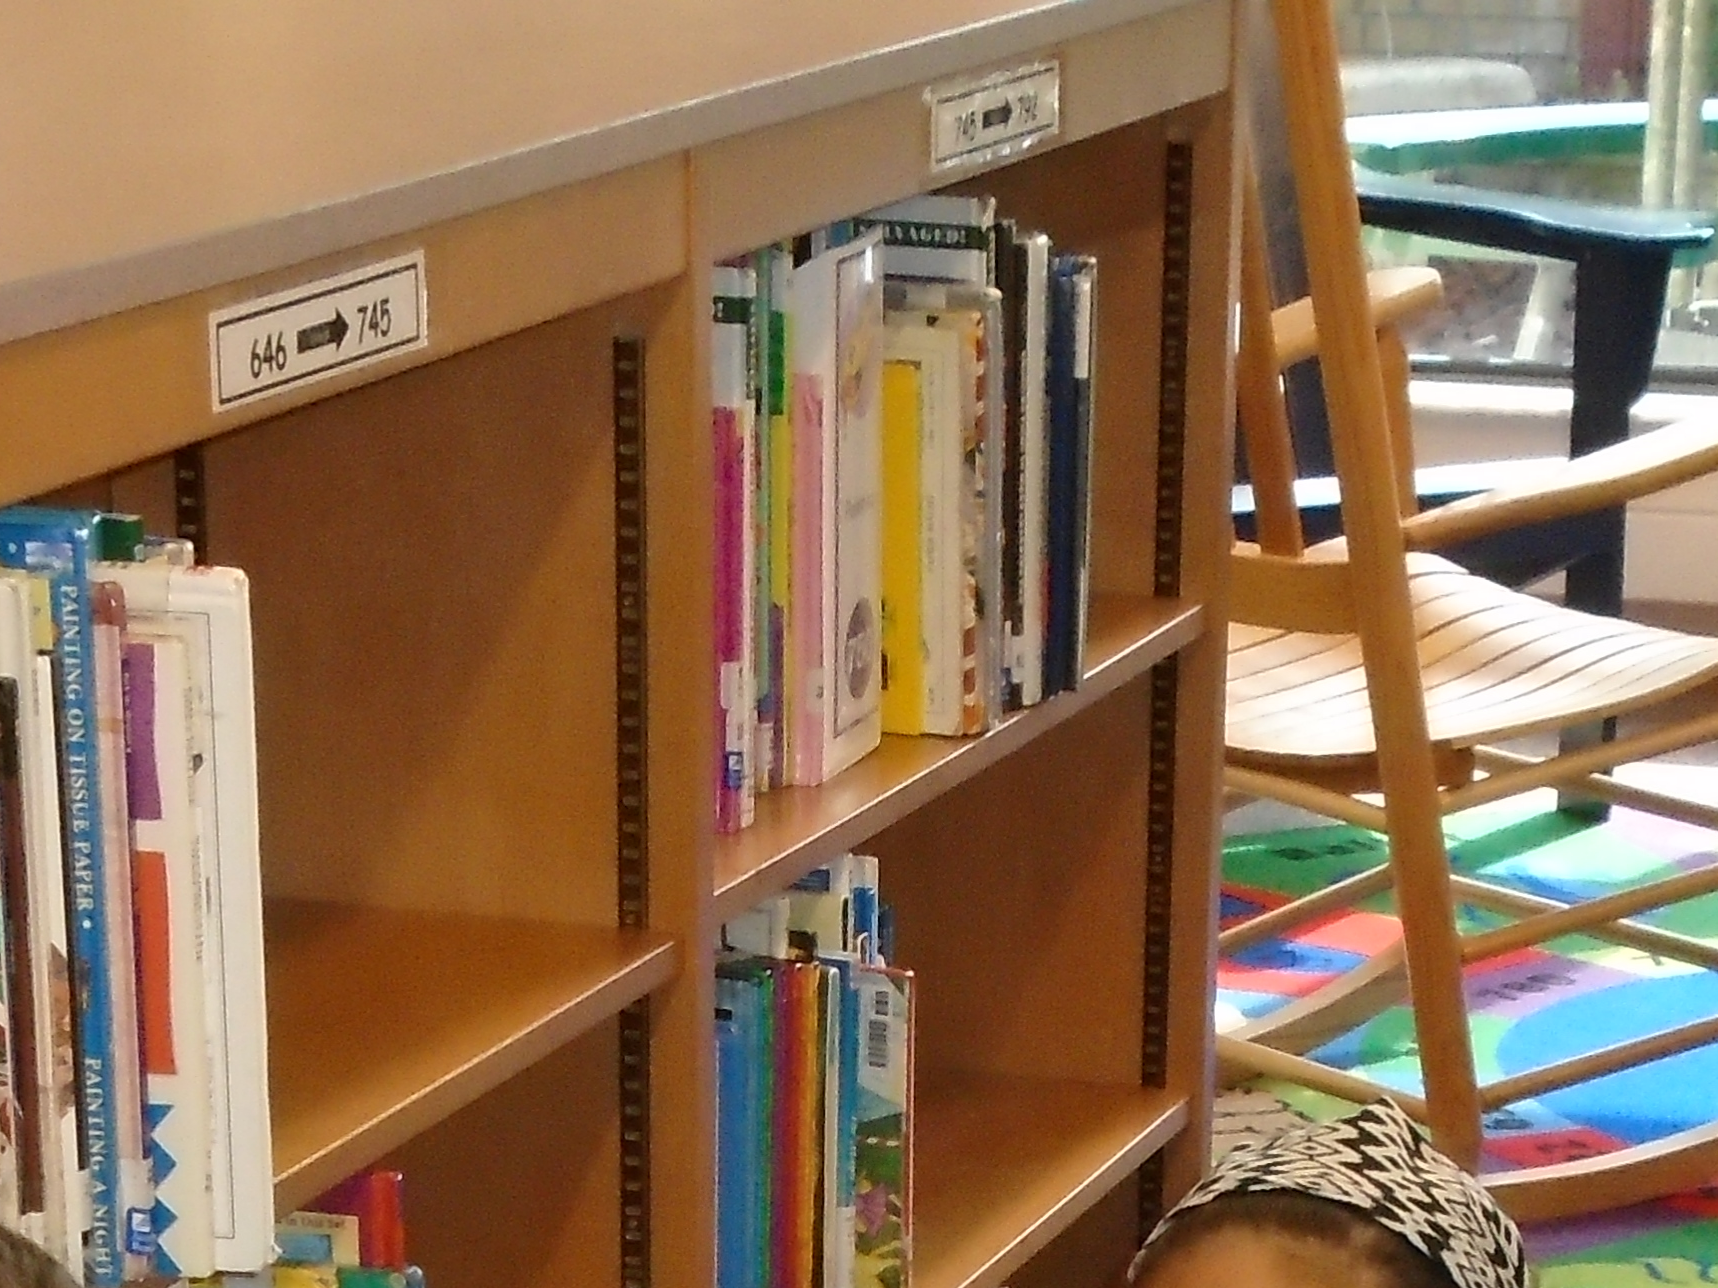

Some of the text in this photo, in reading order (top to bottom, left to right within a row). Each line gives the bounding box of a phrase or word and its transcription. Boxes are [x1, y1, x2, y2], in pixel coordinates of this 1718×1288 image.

[250, 298, 392, 379] 646 745
[62, 585, 95, 910] PAINTING ON TISSUE PAPER
[84, 1058, 113, 1276] PAINTING A NIGHT
